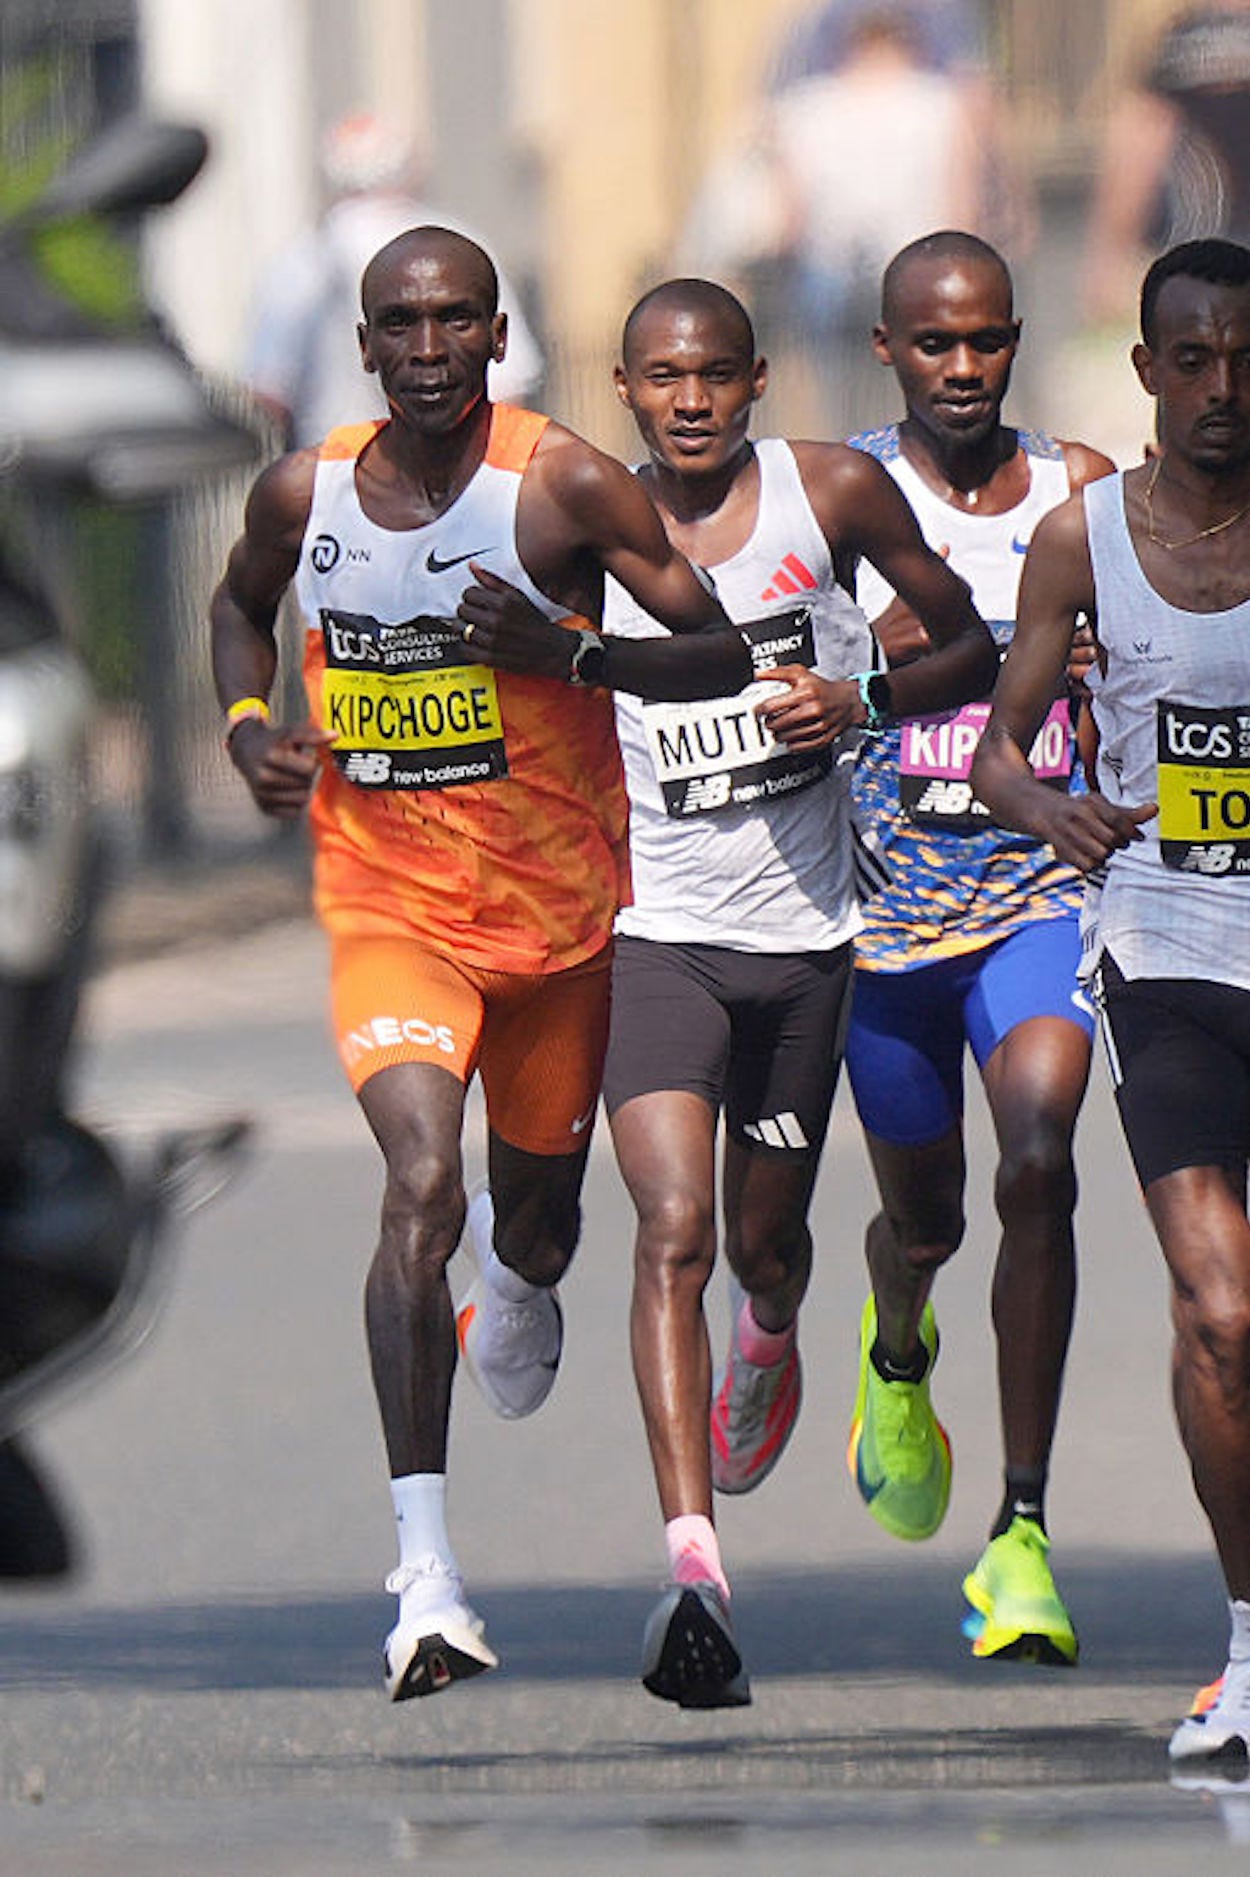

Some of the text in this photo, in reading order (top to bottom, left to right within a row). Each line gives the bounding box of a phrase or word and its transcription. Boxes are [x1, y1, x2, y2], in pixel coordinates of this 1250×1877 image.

[346, 548, 371, 562] NN
[331, 686, 492, 739] KIPCHOGE
[1167, 712, 1232, 758] tcs
[657, 712, 767, 767] MUTI
[909, 721, 1063, 769] KIPO
[393, 770, 423, 785] new
[424, 762, 490, 783] balance
[765, 765, 822, 796] bala
